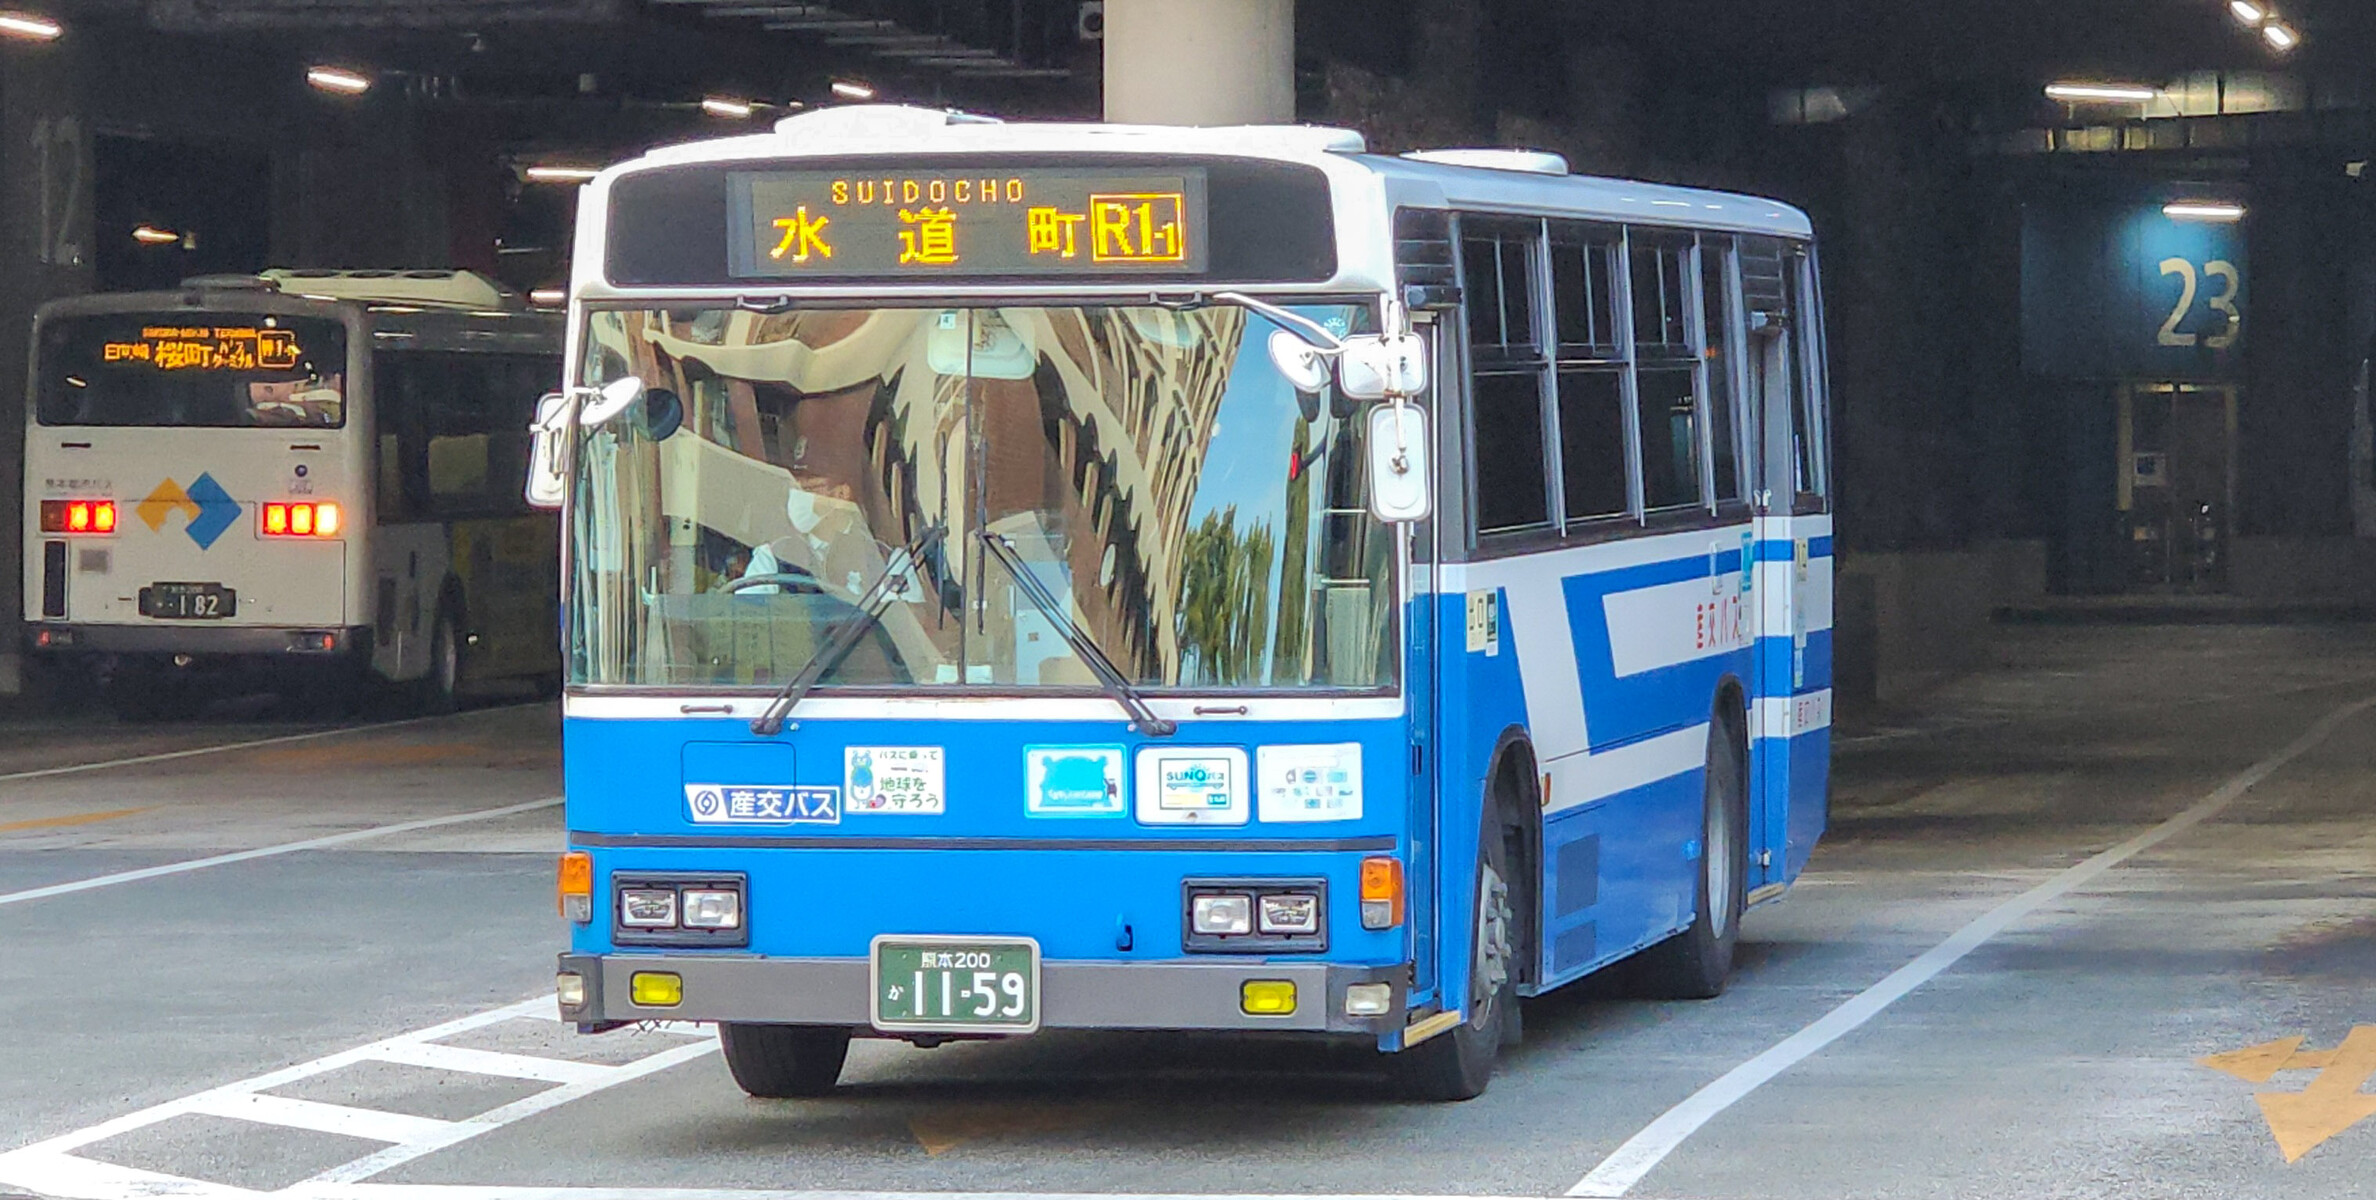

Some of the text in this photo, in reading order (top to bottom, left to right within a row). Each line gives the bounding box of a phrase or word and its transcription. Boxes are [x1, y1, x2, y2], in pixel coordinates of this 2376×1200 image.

[831, 178, 1024, 204] SUIDOCHO
[769, 205, 1086, 263] 水道町
[2156, 257, 2241, 348] 23
[155, 340, 214, 369] 桜町
[880, 776, 927, 792] 地球を
[730, 790, 835, 818] 産交バス
[891, 793, 939, 809] 守ろう
[921, 951, 991, 969] 熊本200
[888, 971, 1025, 1017] か 11-59
